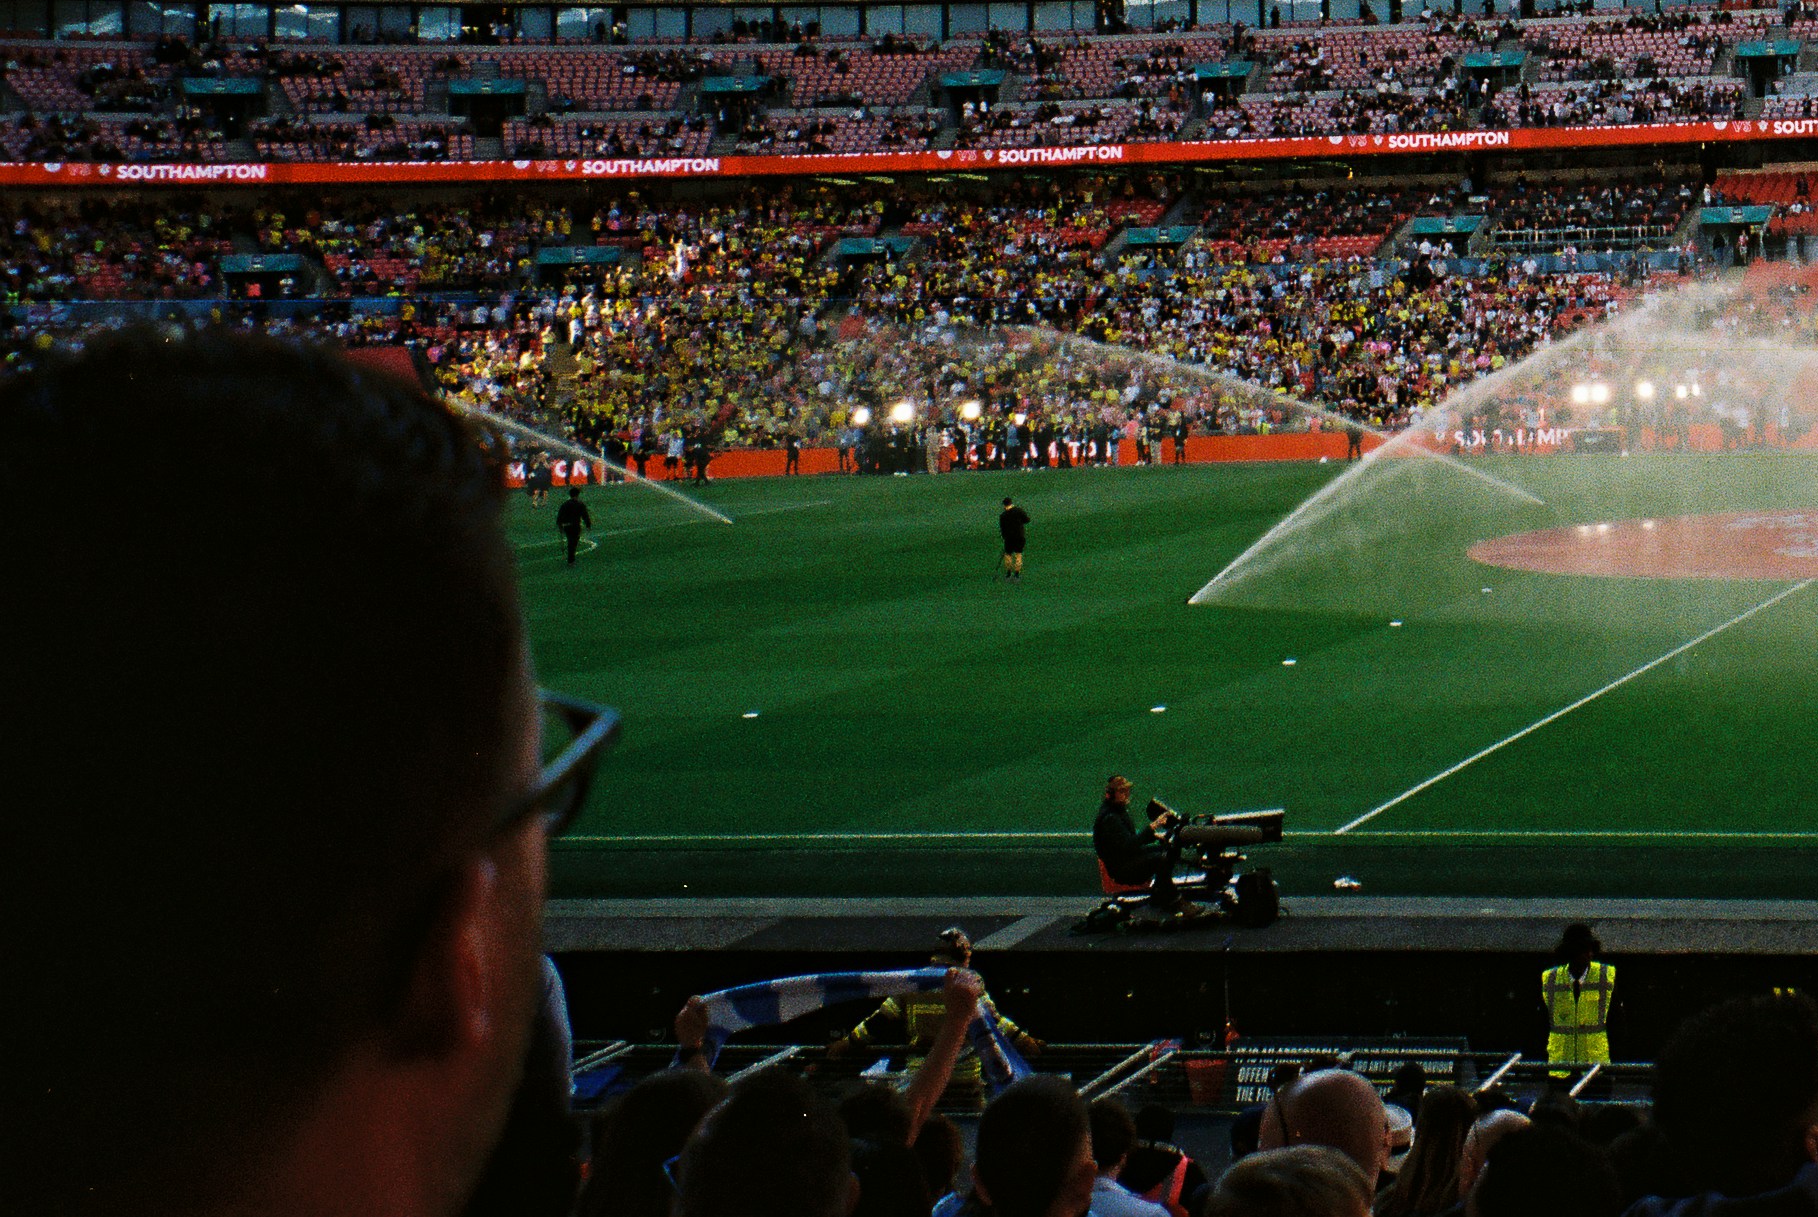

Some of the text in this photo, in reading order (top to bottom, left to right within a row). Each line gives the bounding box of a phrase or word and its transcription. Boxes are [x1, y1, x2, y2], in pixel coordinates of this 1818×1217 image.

[1388, 132, 1508, 148] SOUTHAMPTON
[999, 146, 1122, 163] SOUTHAMPTON
[117, 165, 265, 179] SOUTHAMPTON
[582, 159, 718, 174] SOUTHAMPTON
